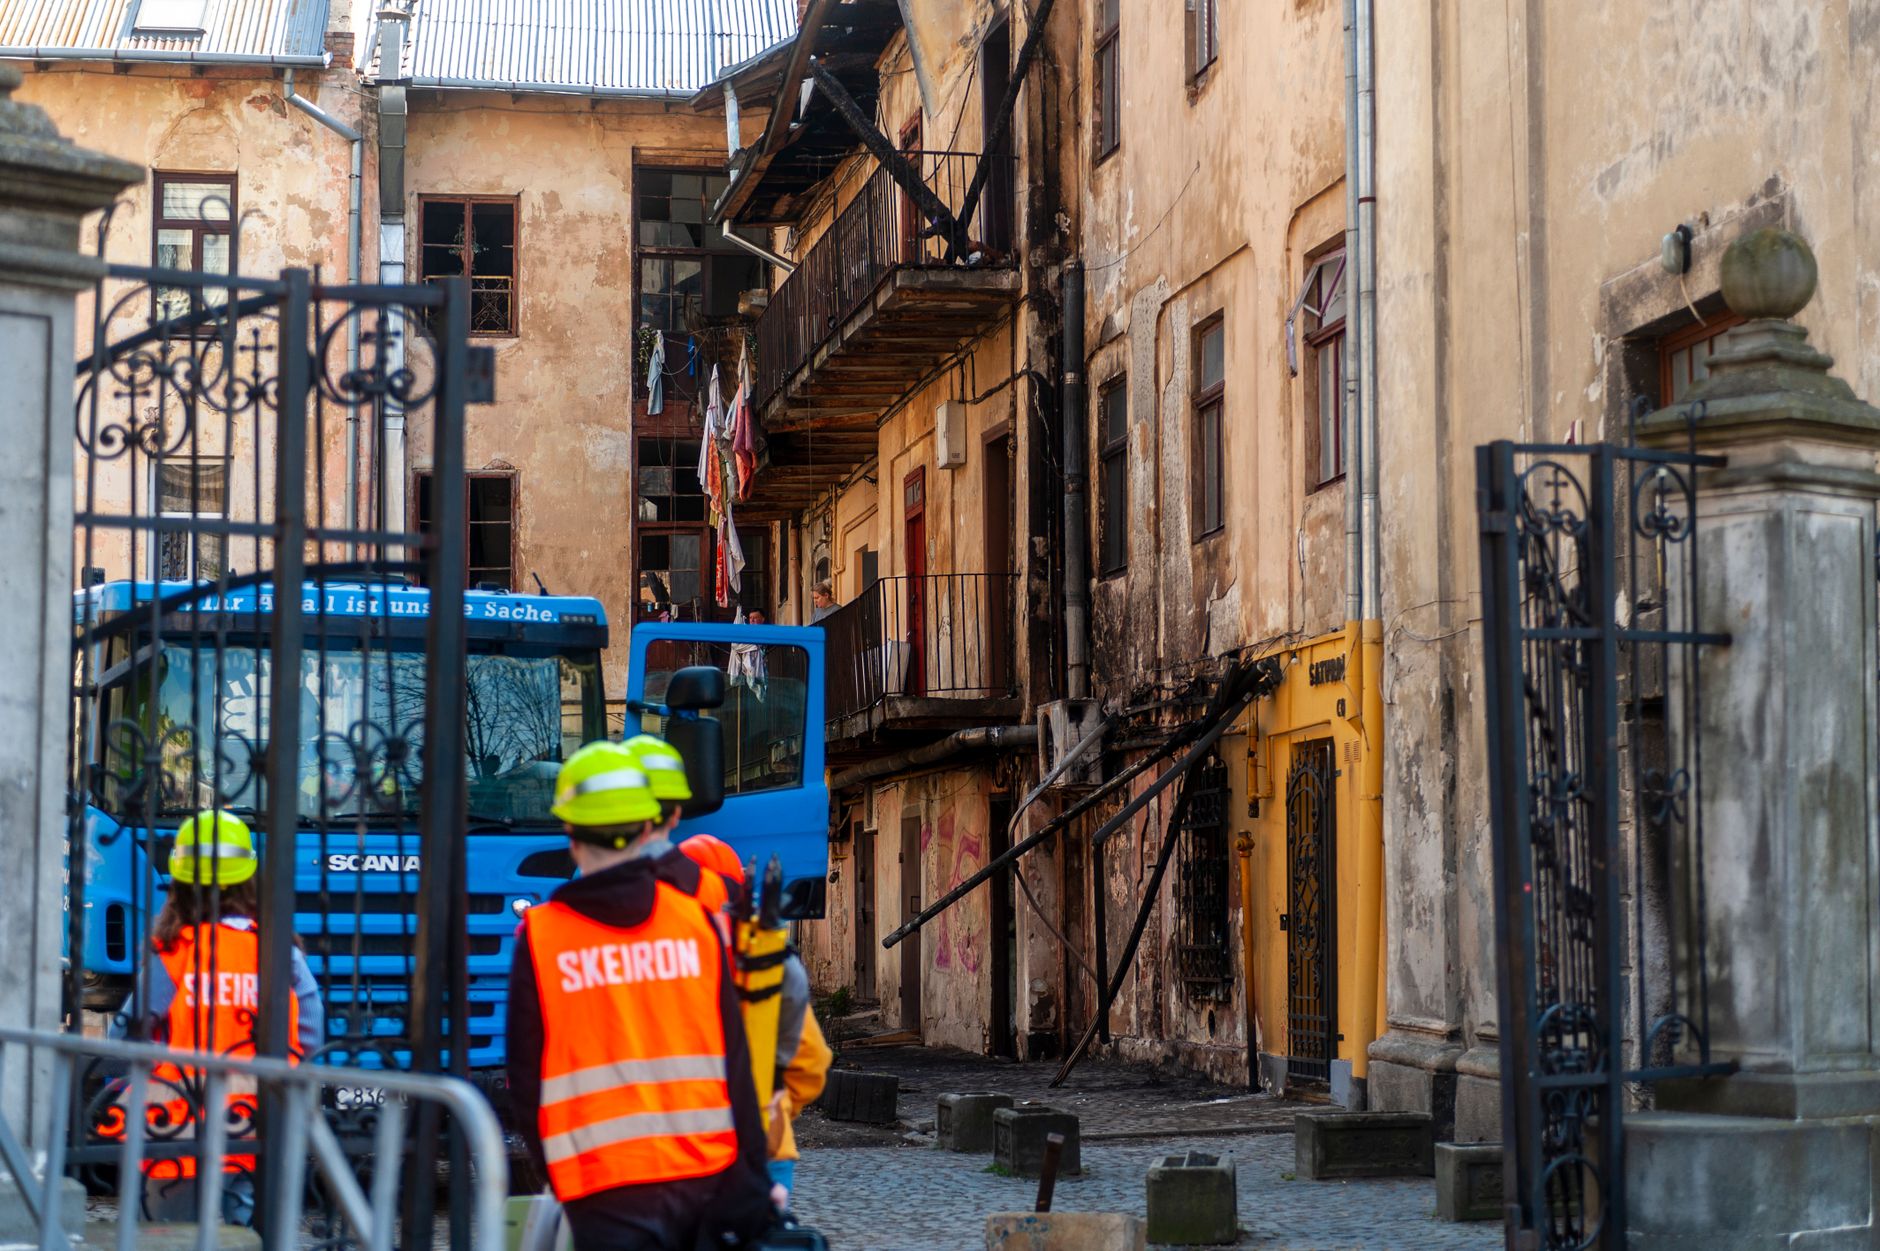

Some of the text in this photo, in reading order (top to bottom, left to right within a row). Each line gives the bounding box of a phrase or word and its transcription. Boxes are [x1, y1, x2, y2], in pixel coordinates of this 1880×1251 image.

[345, 595, 379, 613] ist
[390, 601, 474, 616] unse
[484, 601, 559, 622] Sache.
[556, 937, 701, 993] SKEIRON
[183, 971, 259, 1008] SEIR
